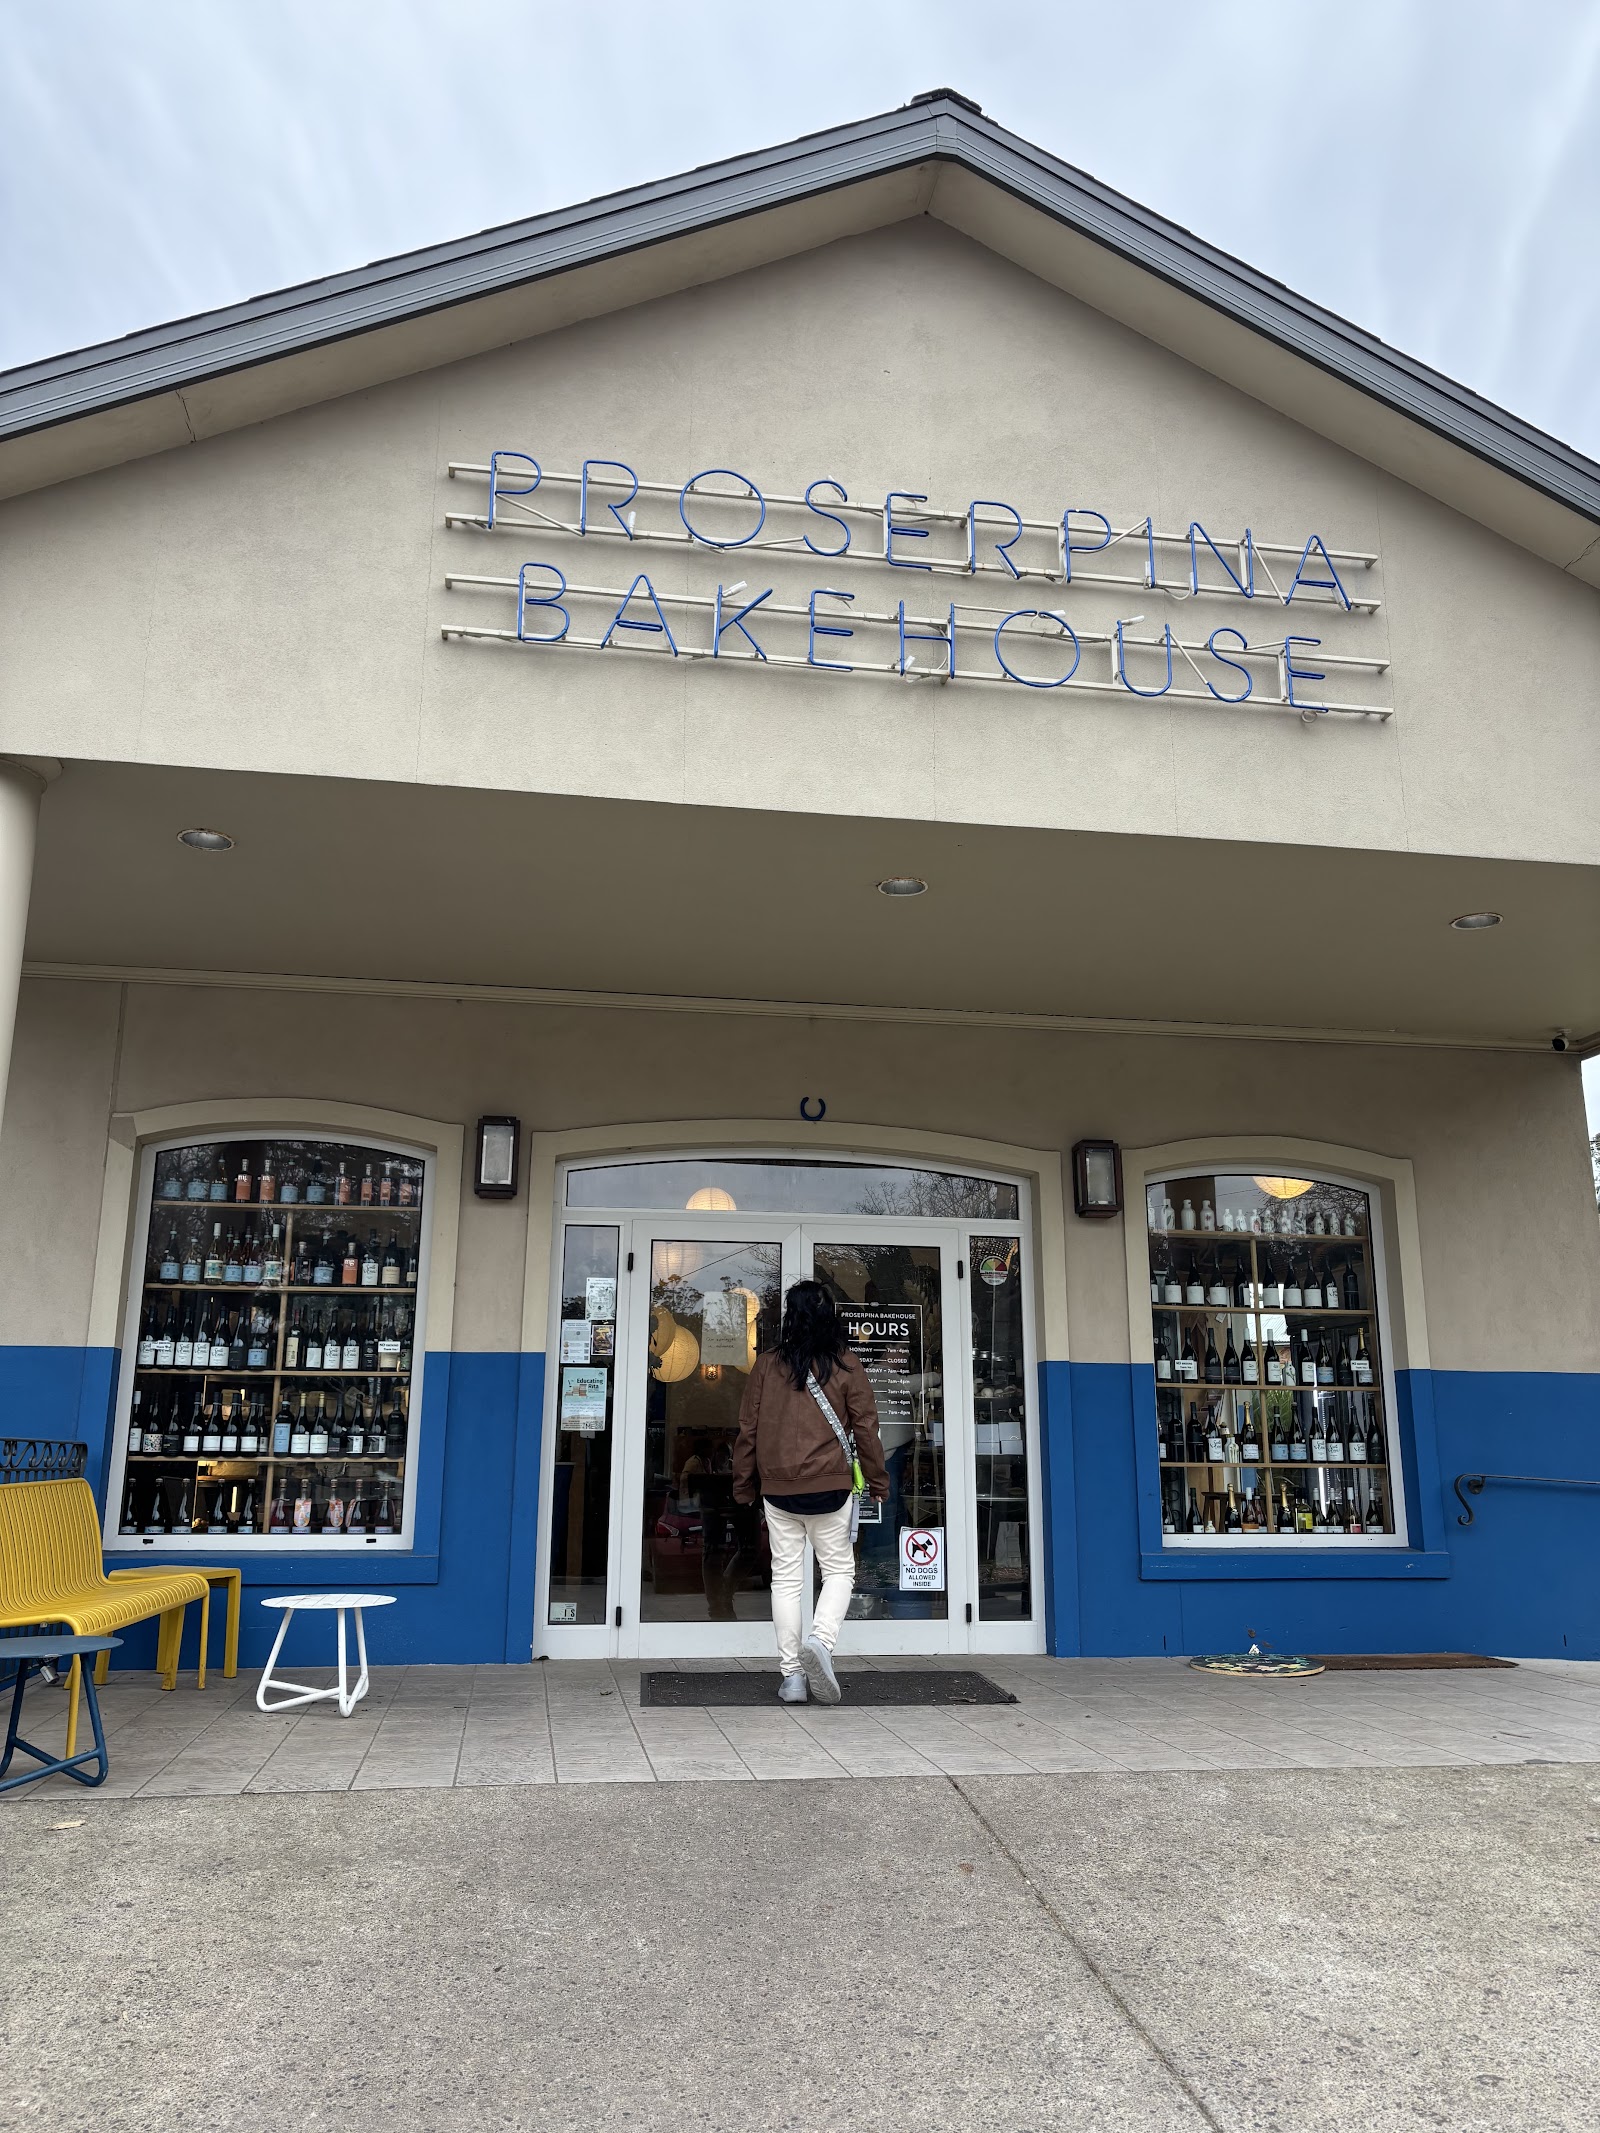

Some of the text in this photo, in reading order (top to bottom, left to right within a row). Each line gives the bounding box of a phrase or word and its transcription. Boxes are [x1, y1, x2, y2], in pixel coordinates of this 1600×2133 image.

[489, 451, 1351, 610] PROSERPINA
[517, 562, 1329, 712] BAKEHOUSE
[849, 1322, 909, 1336] HOURS
